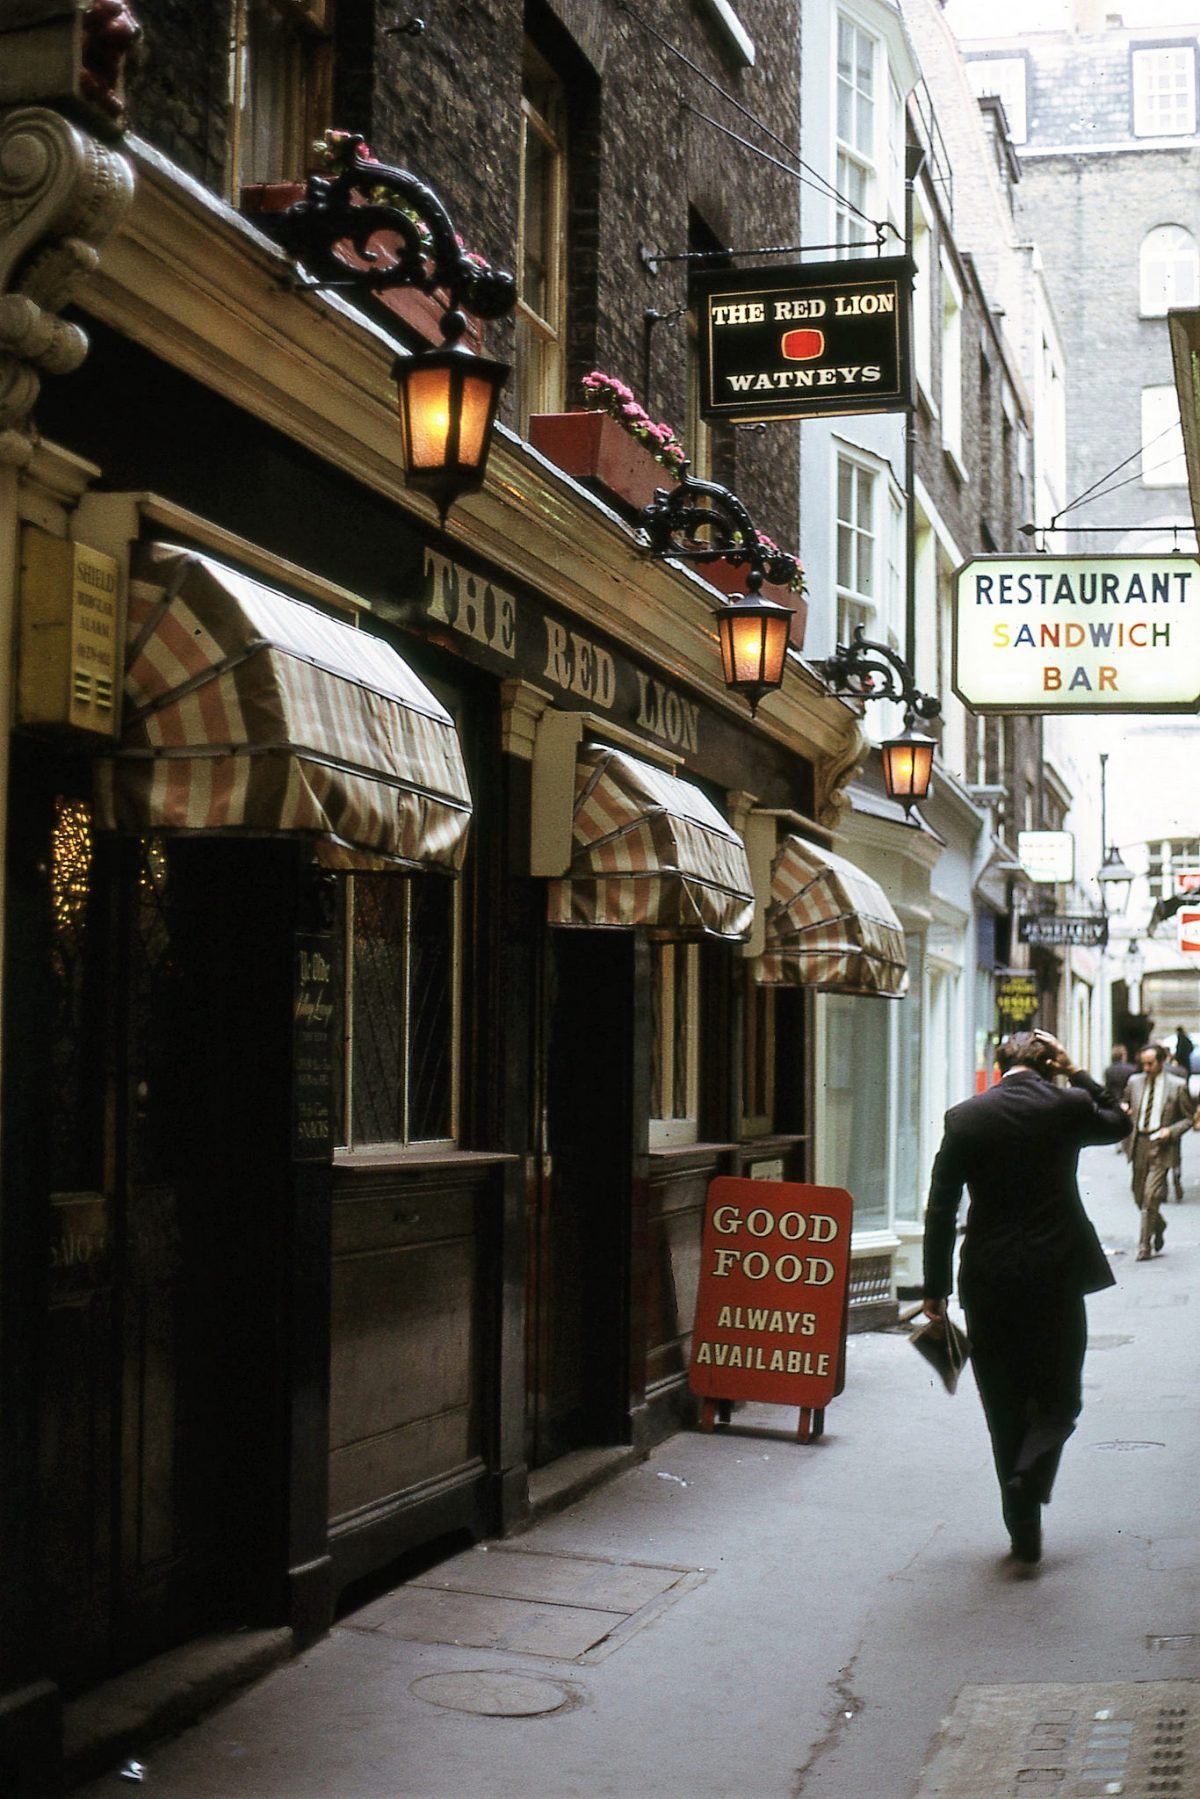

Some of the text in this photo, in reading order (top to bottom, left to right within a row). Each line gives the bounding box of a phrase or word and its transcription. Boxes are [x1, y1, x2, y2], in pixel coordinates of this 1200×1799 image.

[712, 293, 895, 325] THE RED LION
[726, 365, 881, 391] WATNEYS
[77, 562, 114, 593] SHIELD
[976, 572, 1192, 605] RESTAURANT
[424, 546, 699, 754] THE RED LION
[993, 623, 1171, 648] SANDWICH
[1043, 666, 1119, 691] BAR
[712, 1205, 839, 1244] GOOD
[712, 1248, 835, 1287] FOOD
[717, 1306, 816, 1337] ALWAYS
[696, 1341, 830, 1377] AVAILABLE
